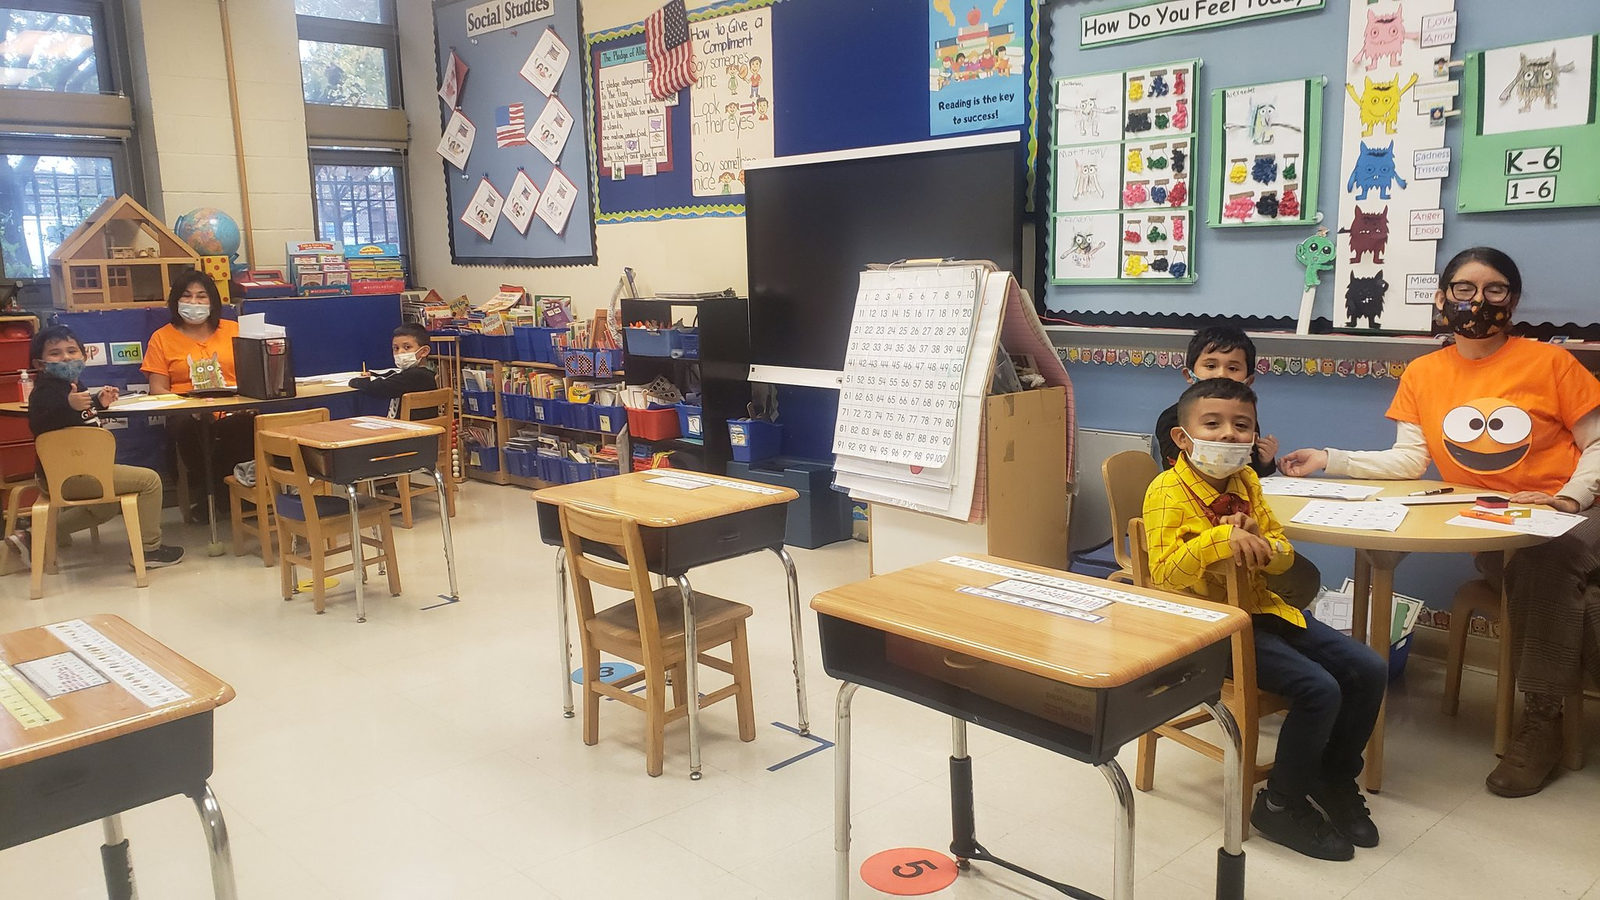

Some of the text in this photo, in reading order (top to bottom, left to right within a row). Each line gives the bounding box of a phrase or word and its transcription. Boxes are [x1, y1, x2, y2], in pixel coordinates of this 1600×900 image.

[468, 0, 549, 31] Social Studies
[1084, 19, 1119, 37] How
[1128, 12, 1151, 30] Do
[1156, 6, 1190, 25] You
[1195, 0, 1236, 19] Feel
[1427, 17, 1454, 29] Love
[691, 17, 763, 41] How to Give a
[703, 31, 753, 55] Compliment
[1424, 32, 1454, 44] Amor
[696, 73, 717, 90] ame
[693, 92, 720, 117] Look
[939, 93, 1015, 111] Reading is the key
[953, 110, 999, 125] to success!
[695, 151, 716, 177] Say
[694, 176, 716, 191] nice
[1413, 212, 1441, 222] Anger
[1415, 226, 1440, 236] Enojo
[1410, 276, 1438, 285] Miedo
[886, 293, 890, 301] 3
[920, 292, 925, 300] 6
[933, 292, 937, 300] 7
[944, 291, 949, 299] 8
[957, 291, 961, 299] 9
[966, 290, 974, 299] 10
[1414, 290, 1433, 300] Fear
[892, 309, 899, 317] 14
[903, 309, 910, 317] 15
[915, 309, 922, 317] 16
[926, 309, 934, 317] 17
[939, 309, 946, 317] 18
[951, 309, 959, 317] 19
[962, 309, 972, 317] 20
[854, 326, 968, 336] 21 22 23 24 25 26 27 28 29 30
[118, 347, 139, 358] and
[861, 343, 870, 351] 32
[873, 343, 881, 352] 33
[884, 344, 892, 352] 34
[895, 344, 904, 352] 35
[907, 344, 916, 353] 36
[919, 344, 928, 353] 37
[931, 345, 940, 354] 38
[943, 345, 953, 354] 39
[956, 345, 965, 354] 40
[858, 359, 867, 367] 42
[869, 359, 877, 368] 43
[879, 360, 889, 368] 44
[891, 361, 900, 369] 45
[903, 361, 912, 370] 46
[915, 362, 924, 370] 47
[927, 362, 936, 371] 48
[940, 363, 949, 372] 49
[953, 363, 962, 373] 50
[846, 375, 959, 391] 51 52 53 54 55 56 57 58 59 60
[854, 393, 863, 401] 62
[876, 394, 884, 403] 64
[887, 395, 895, 404] 65
[899, 396, 907, 405] 66
[911, 397, 919, 405] 67
[923, 398, 932, 407] 68
[935, 399, 944, 408] 69
[948, 400, 957, 409] 70
[842, 408, 954, 428] 71 72 73 74 75 76 77 78 79 80
[839, 424, 952, 446] 81 82 83 84 85 86 87 88 89 90
[837, 440, 946, 463] 91 92 93 94 95 96 97 98 99 100
[892, 859, 938, 878] 5
